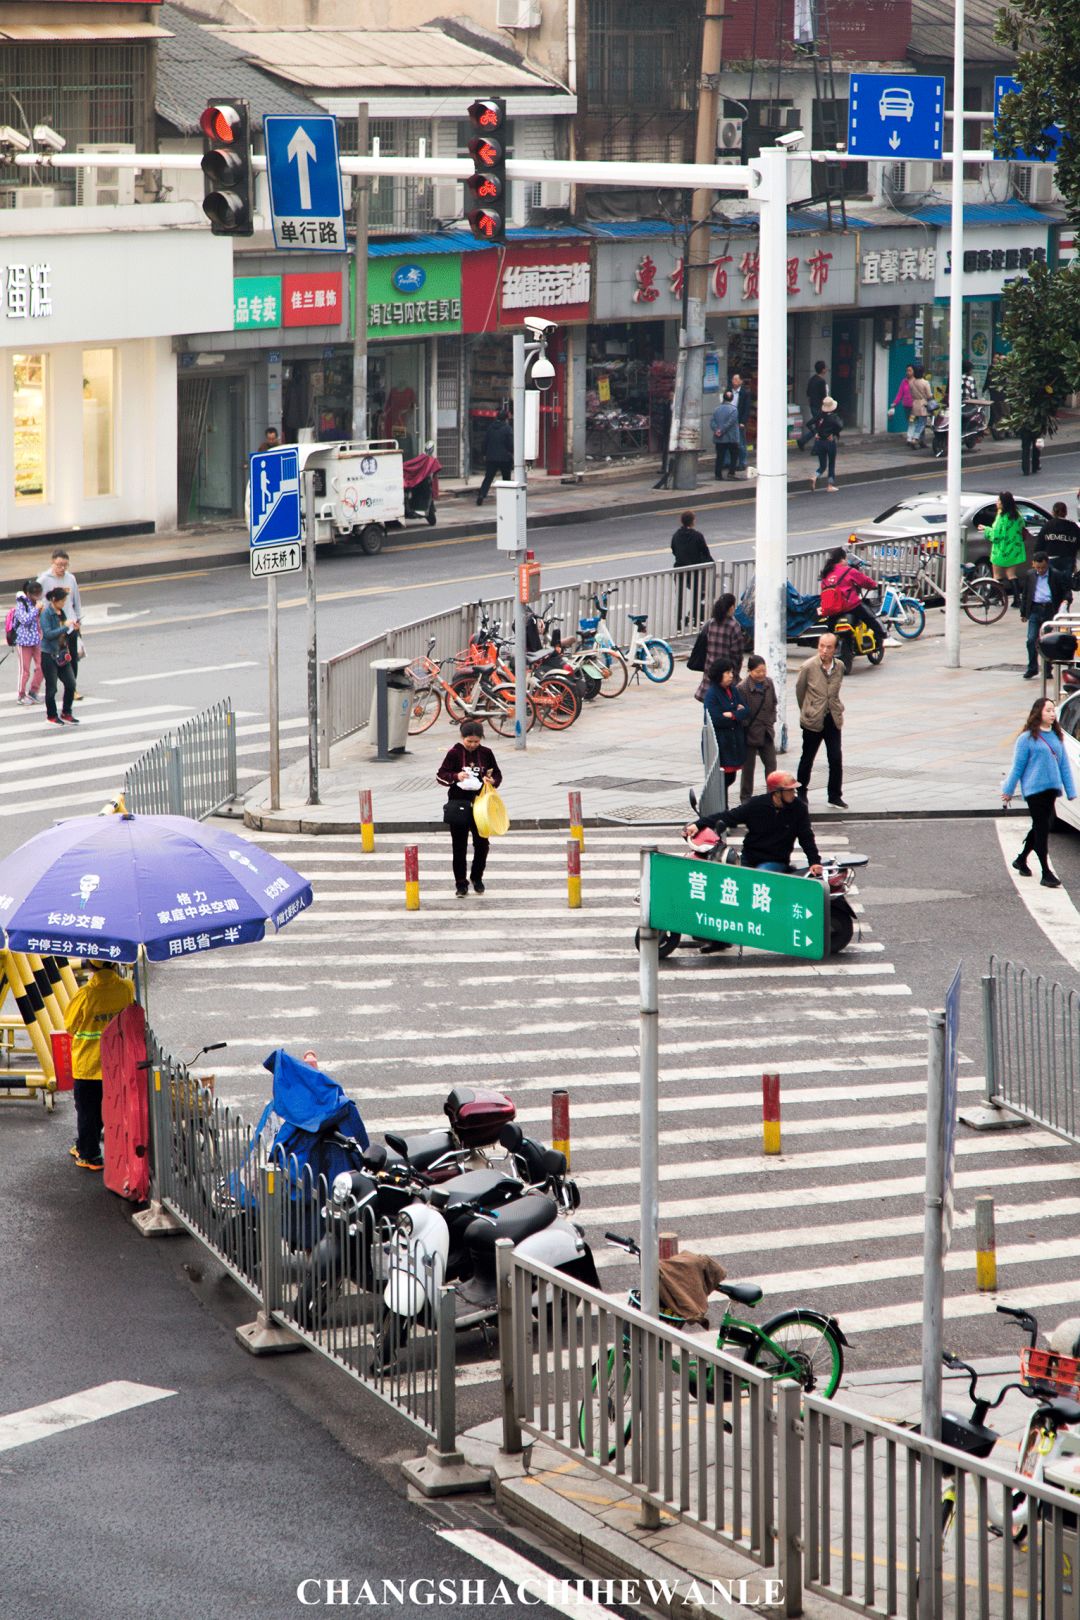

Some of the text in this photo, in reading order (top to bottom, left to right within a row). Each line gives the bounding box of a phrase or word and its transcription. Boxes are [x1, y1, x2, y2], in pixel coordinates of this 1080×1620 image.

[281, 220, 338, 244] 单行路
[861, 246, 937, 284] 宜馨宾馆
[0, 264, 53, 318] 蛋糕
[291, 289, 337, 309] 佳兰服饰
[233, 294, 277, 323] 品专卖
[366, 298, 461, 327] 海飞马内衣专卖店
[254, 550, 288, 571] 人行天桥
[176, 890, 208, 906] 格力
[688, 871, 772, 913] 营盘路
[47, 911, 106, 930] 长沙交警
[157, 898, 240, 924] 家庭中央空调
[792, 903, 804, 920] 东
[695, 911, 765, 937] Yingpan Rd.
[27, 938, 122, 958] 宁停三分 不抢一秒
[168, 927, 240, 956] 用电省一半
[792, 929, 802, 948] E
